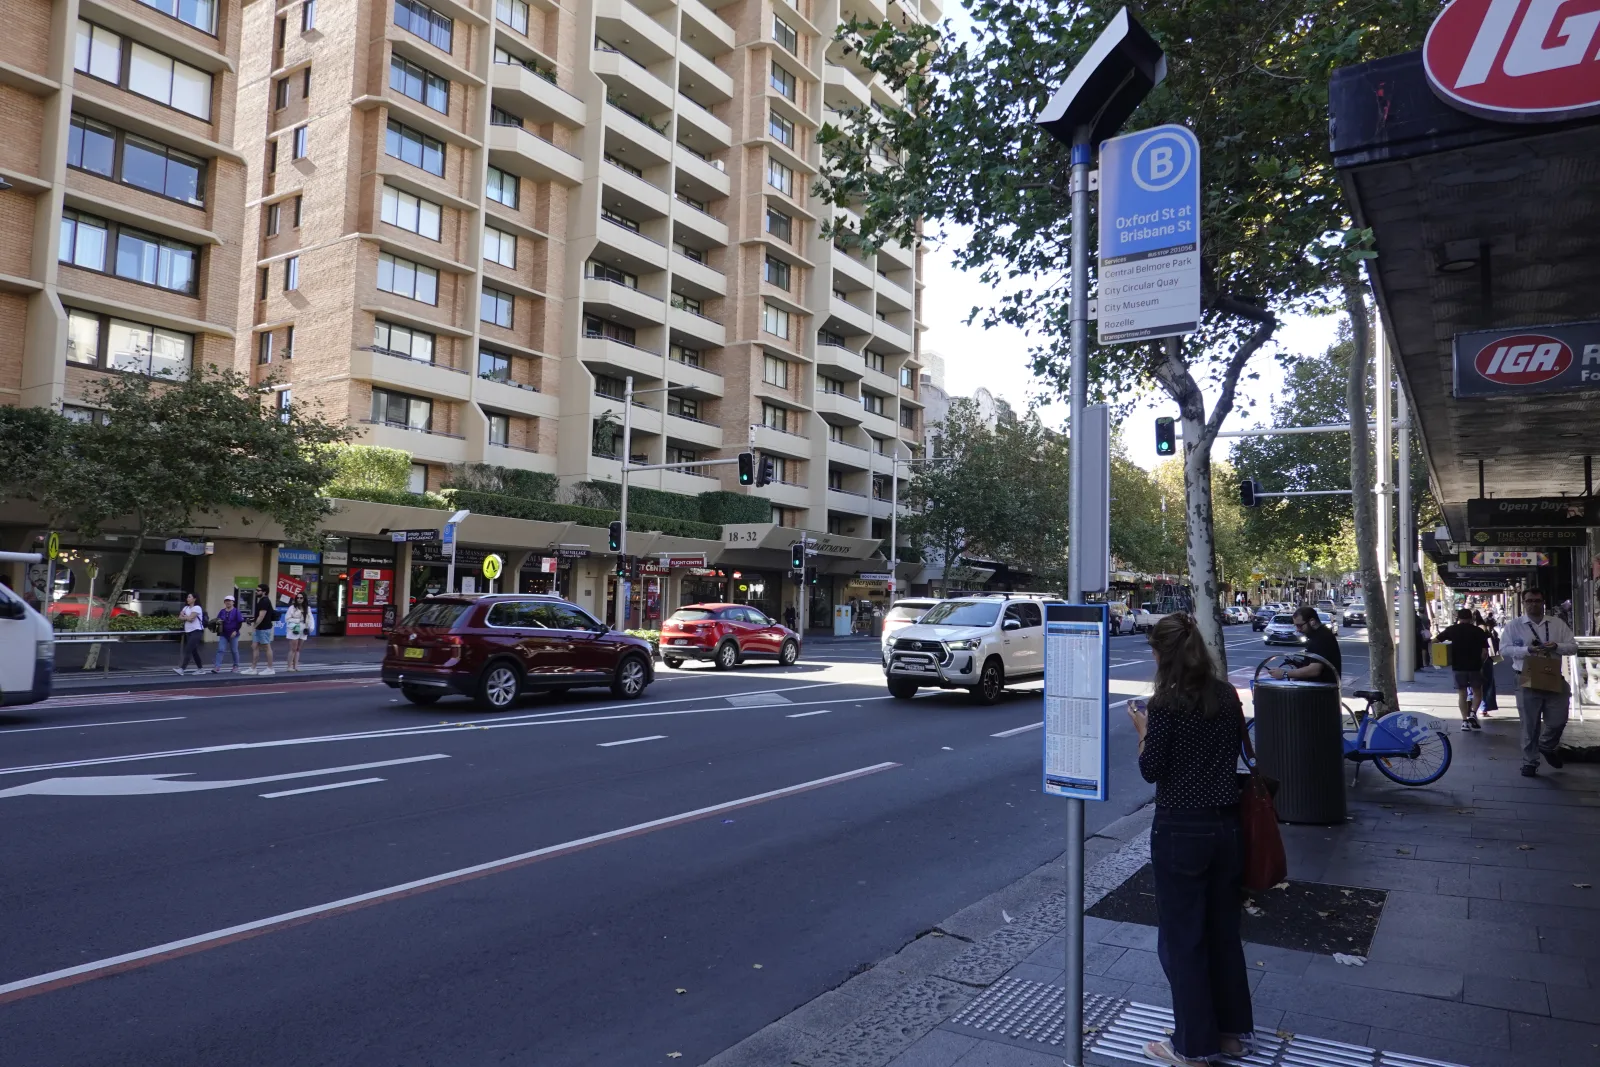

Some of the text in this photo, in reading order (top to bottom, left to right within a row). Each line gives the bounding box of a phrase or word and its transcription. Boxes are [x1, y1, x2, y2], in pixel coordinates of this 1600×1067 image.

[1453, 0, 1600, 89] IG
[1150, 146, 1174, 181] B
[1116, 204, 1192, 230] Oxford St at
[1120, 220, 1192, 244] Brisbane St
[1104, 257, 1127, 266] Services
[1170, 244, 1193, 254] 201056
[1104, 257, 1192, 279] Central Belmore Park
[1104, 277, 1180, 297] City Circular Quay
[1104, 298, 1159, 314] City Museum
[1104, 318, 1135, 329] Rozelle
[1104, 329, 1151, 341] transportnsw.info
[1485, 342, 1561, 375] IGA
[1499, 501, 1569, 512] Open 7 Days
[728, 532, 738, 542] 18
[746, 532, 757, 541] 32
